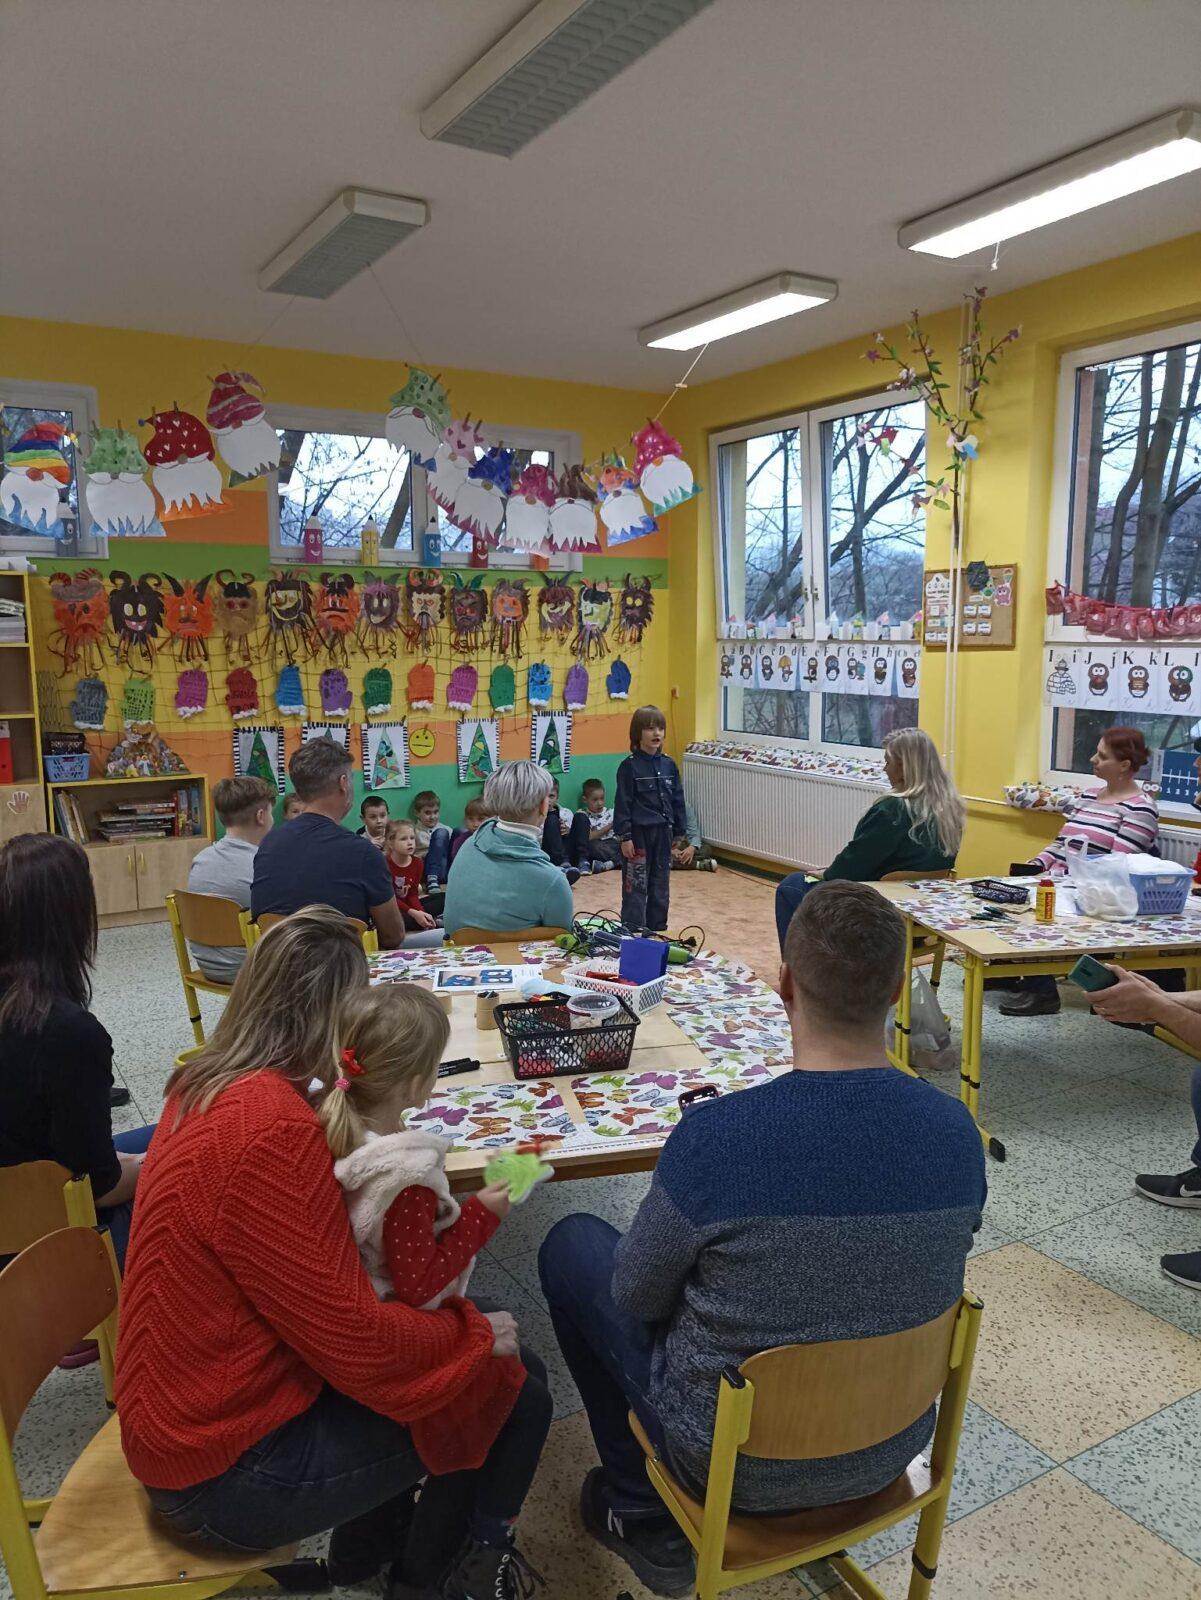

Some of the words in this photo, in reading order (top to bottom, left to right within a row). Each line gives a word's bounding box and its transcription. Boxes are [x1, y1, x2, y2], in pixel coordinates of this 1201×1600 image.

[759, 646, 766, 656] C
[779, 646, 786, 655] D
[791, 646, 797, 655] d
[847, 647, 855, 657] G
[871, 646, 880, 657] H
[886, 647, 893, 657] h
[1048, 649, 1054, 663] I
[1072, 649, 1078, 663] i
[1084, 651, 1093, 664] J
[1110, 651, 1116, 669] j
[1123, 650, 1135, 664] K
[1149, 651, 1158, 665] k
[1164, 652, 1174, 666] L
[1194, 652, 1199, 667] l
